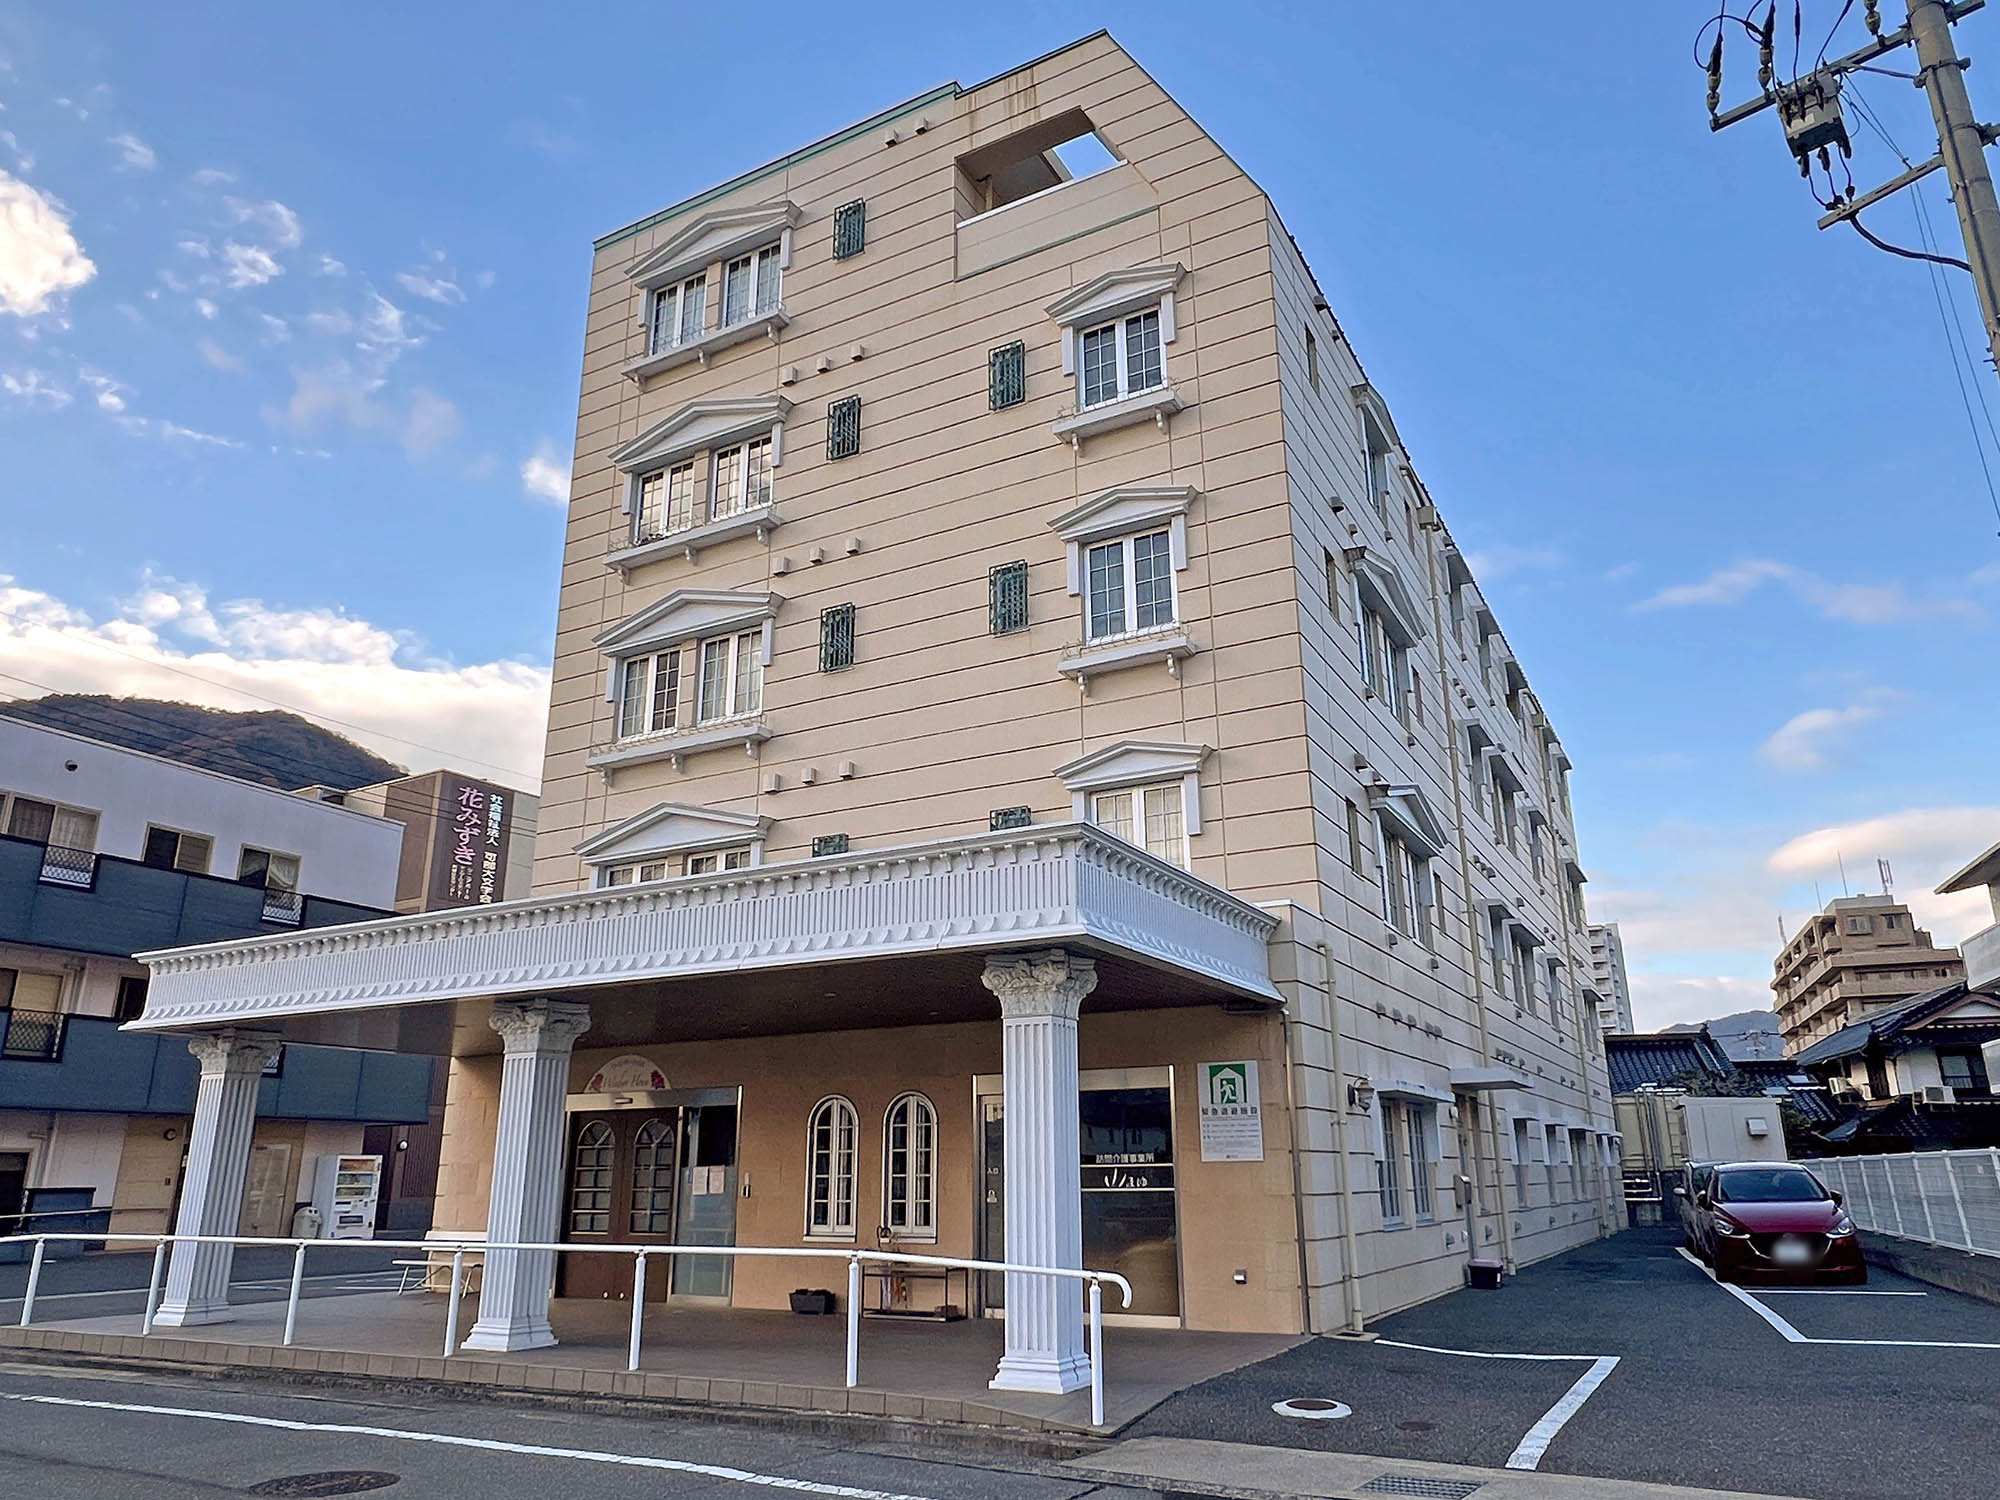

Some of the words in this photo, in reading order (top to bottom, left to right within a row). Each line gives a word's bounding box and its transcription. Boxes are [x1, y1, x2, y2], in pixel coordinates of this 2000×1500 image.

[453, 786, 484, 866] 花みずき
[485, 794, 503, 847] 社会福祉法人
[479, 851, 498, 904] 可部大文字会
[986, 1167, 999, 1175] 入口
[1095, 1152, 1155, 1164] 訪問介護事業所
